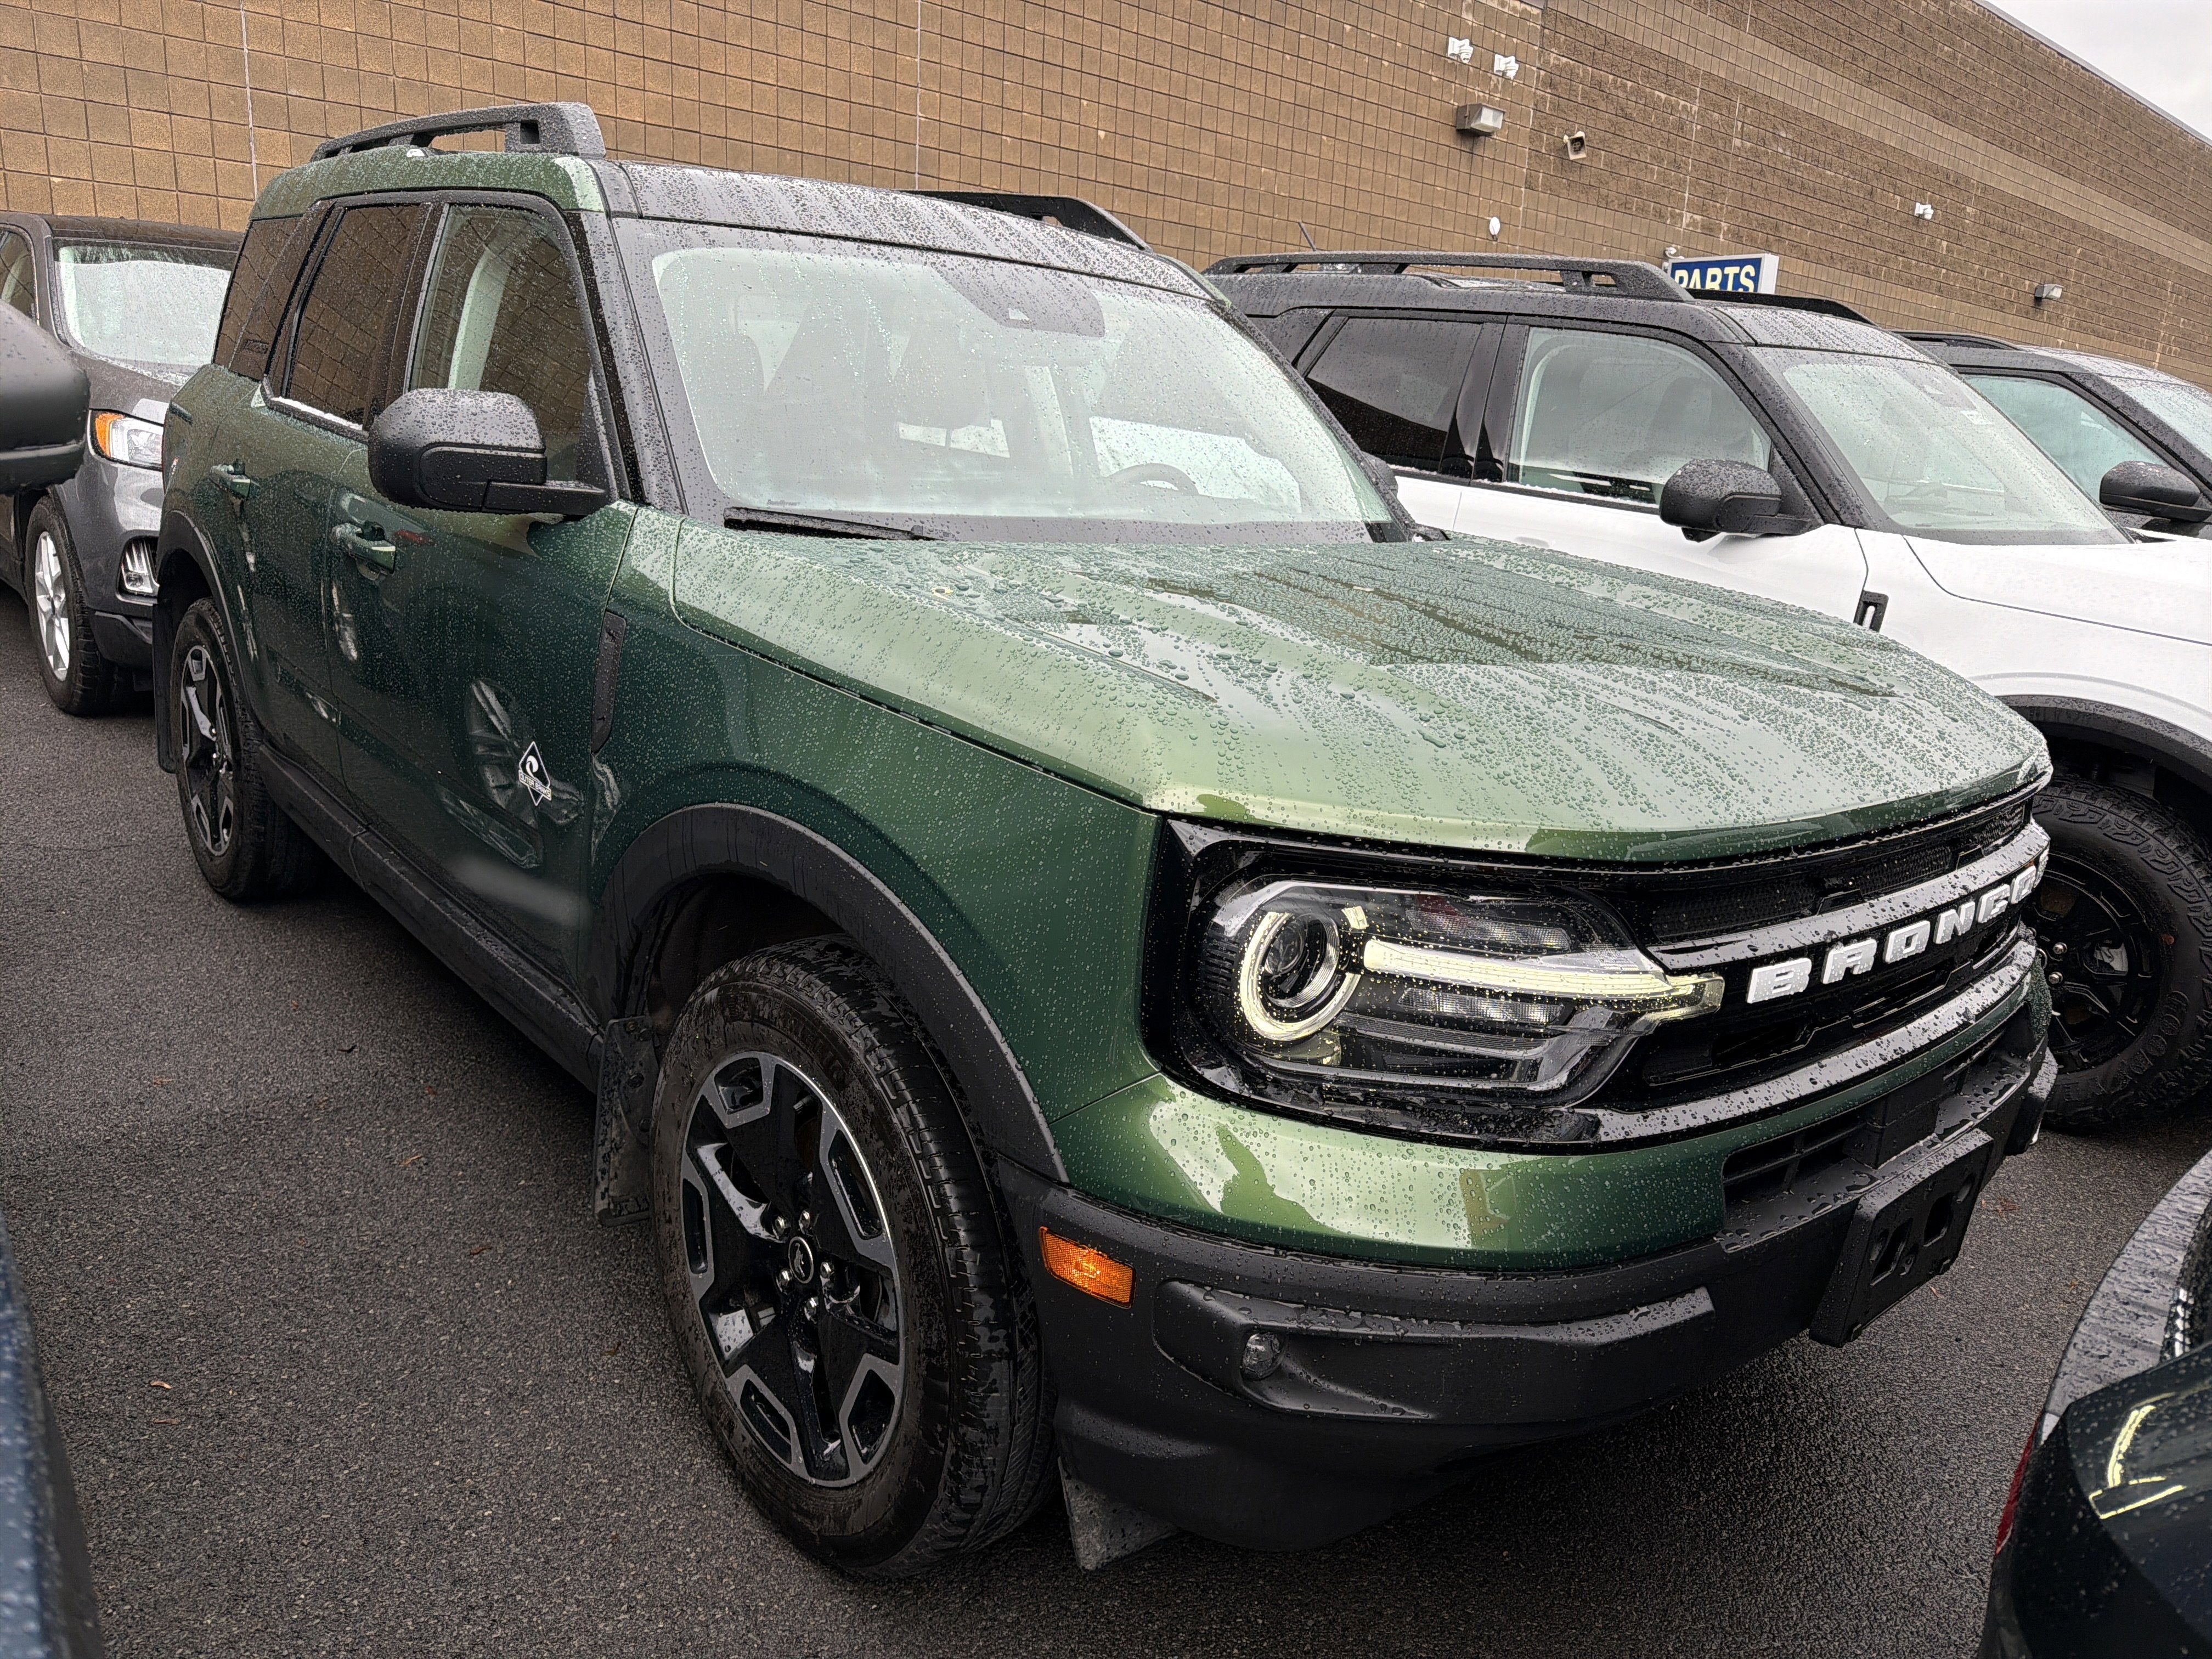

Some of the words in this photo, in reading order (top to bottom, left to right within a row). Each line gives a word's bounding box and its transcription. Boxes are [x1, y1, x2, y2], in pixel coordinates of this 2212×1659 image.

[1675, 265, 1756, 292] PARTS
[521, 773, 535, 787] OUTER
[535, 783, 550, 797] BANKS
[1746, 865, 2036, 1003] BRONCO
